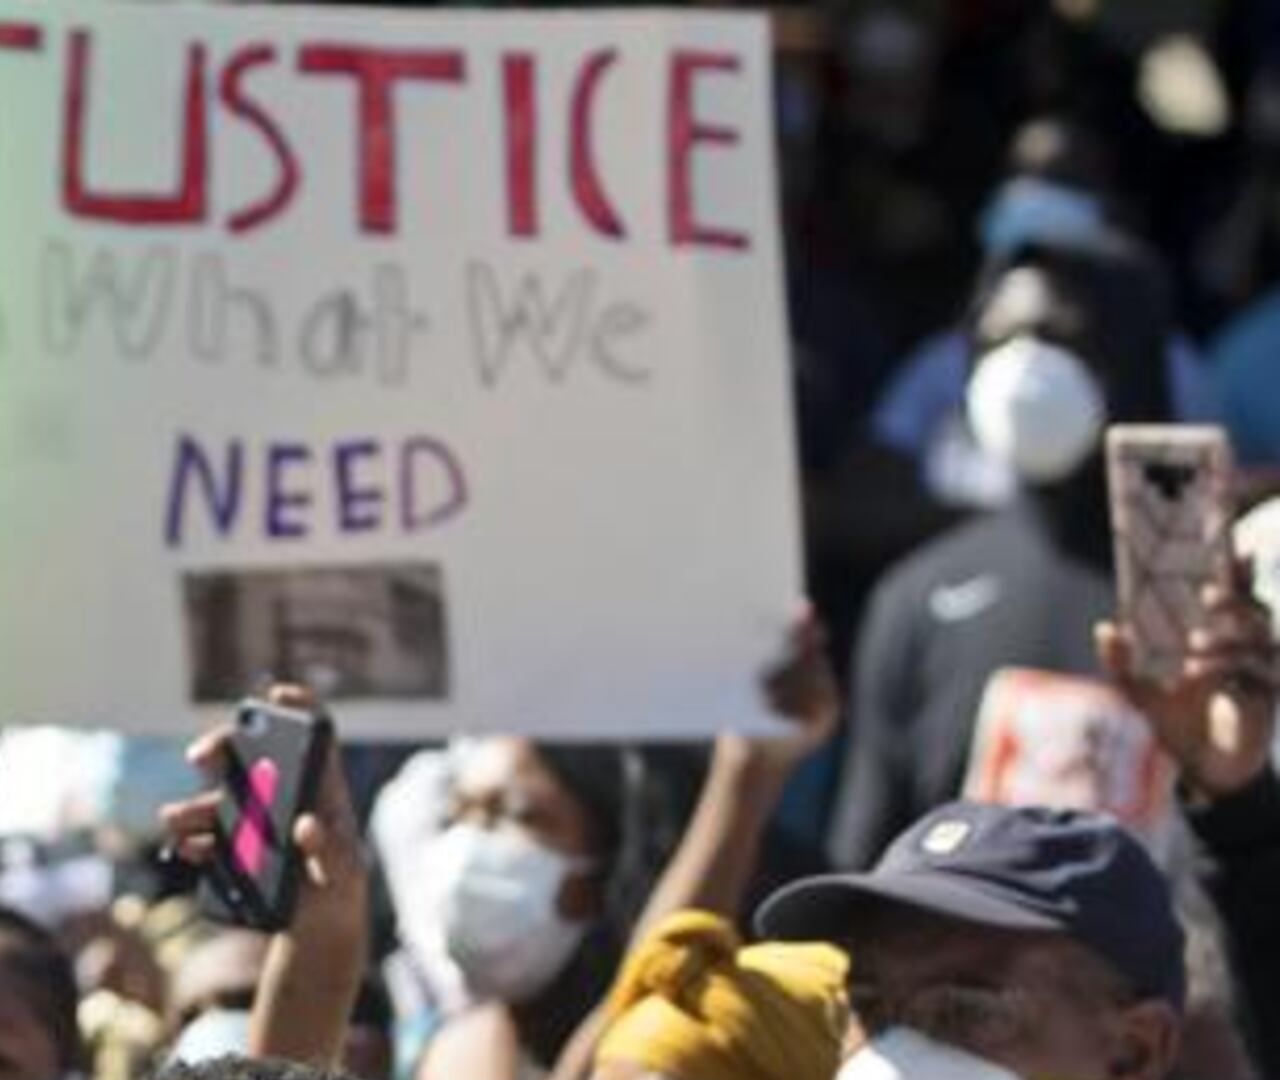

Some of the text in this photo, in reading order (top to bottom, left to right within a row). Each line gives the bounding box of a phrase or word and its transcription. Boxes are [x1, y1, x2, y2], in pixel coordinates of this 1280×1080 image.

[40, 236, 430, 388] What
[463, 258, 653, 390] We
[164, 433, 471, 550] NEED
